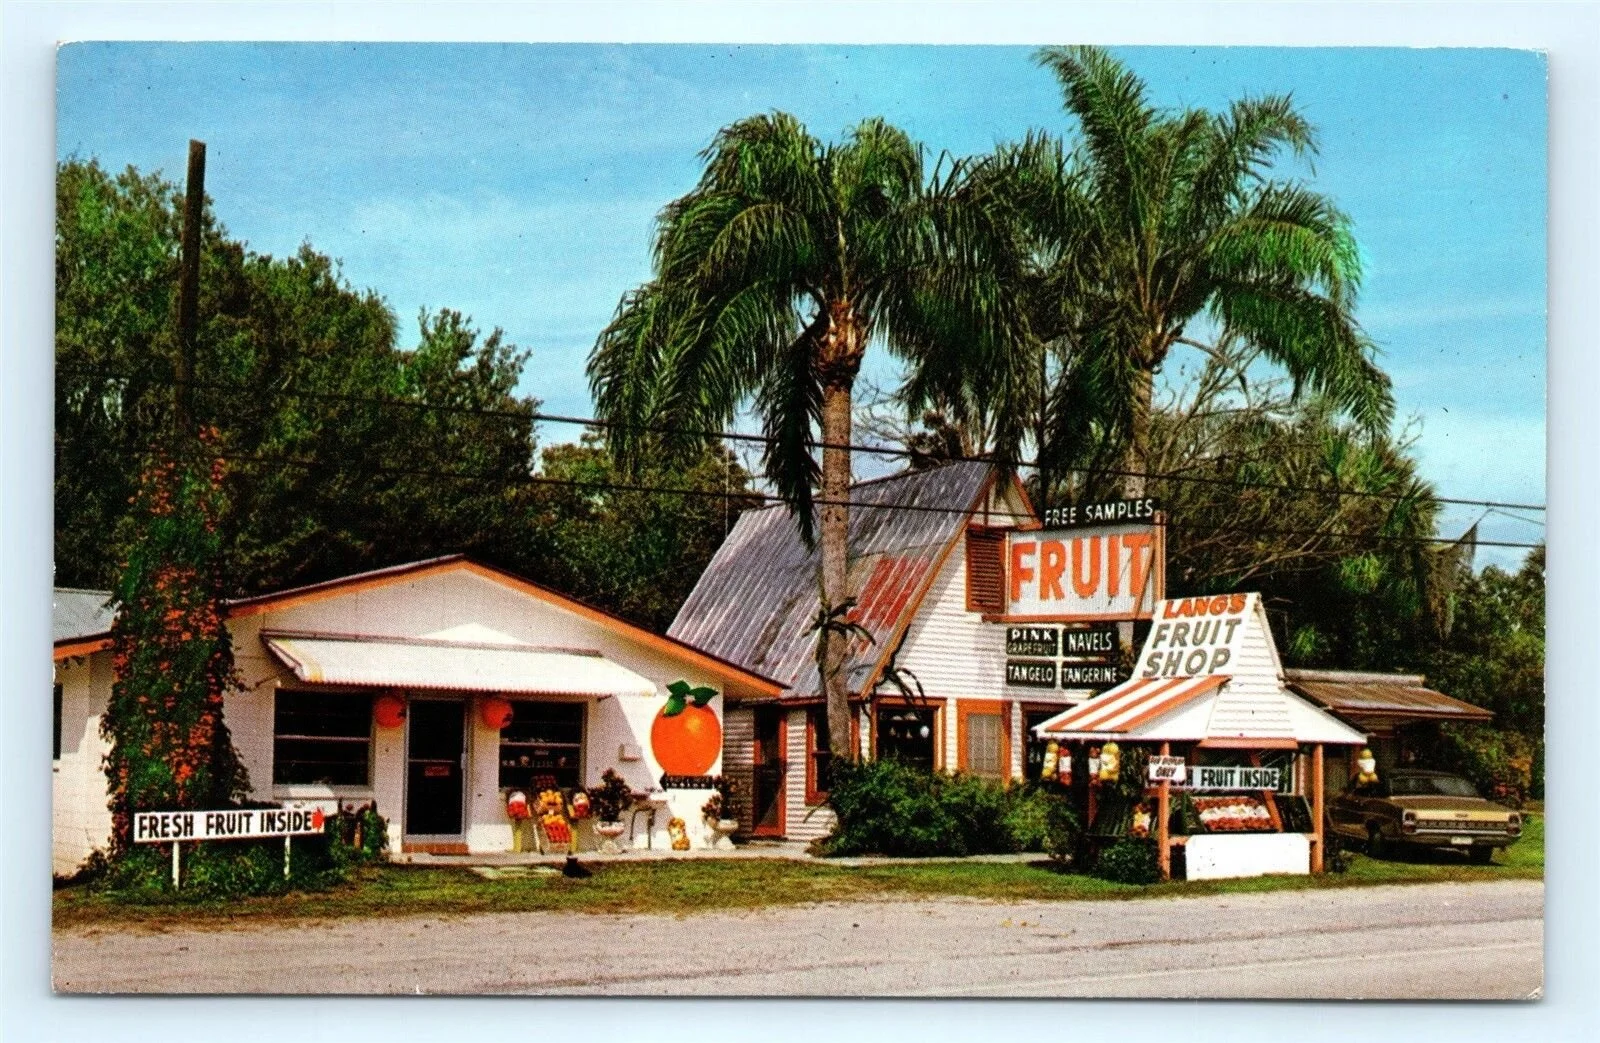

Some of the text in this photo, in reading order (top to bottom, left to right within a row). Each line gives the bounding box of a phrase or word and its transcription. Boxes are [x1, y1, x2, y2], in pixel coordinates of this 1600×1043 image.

[1045, 499, 1153, 526] FREE SAMPLES
[1010, 532, 1154, 603] FRUIT
[1011, 629, 1052, 640] PINK
[1068, 632, 1112, 651] NAVELS
[1152, 618, 1242, 649] FRUIT
[1007, 642, 1056, 654] GRAPEFRUIT
[1142, 648, 1231, 678] SHOP
[1008, 666, 1054, 681] TANGELO
[1063, 667, 1117, 683] TANGERINE
[1201, 769, 1236, 787] FRUIT
[1239, 769, 1278, 788] INSIDE
[138, 810, 312, 838] FRESH FRUIT INSIDE
